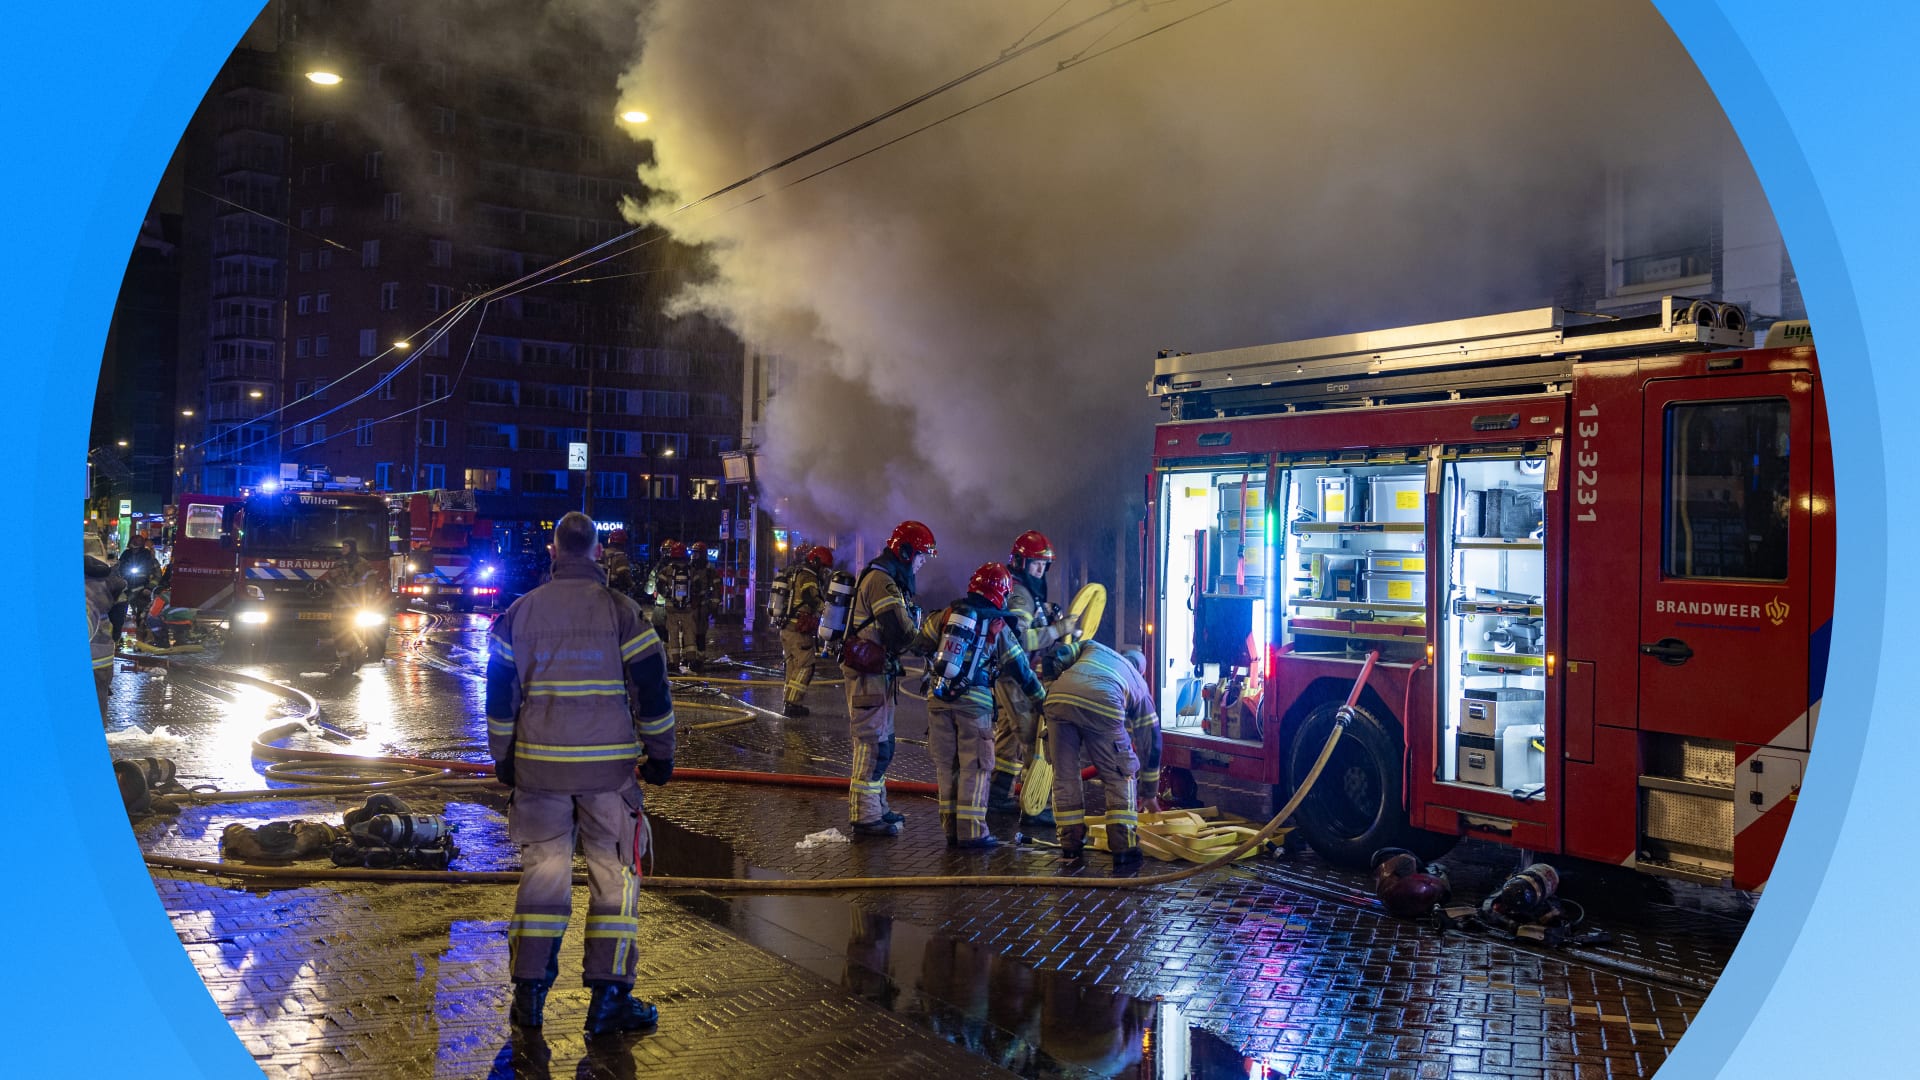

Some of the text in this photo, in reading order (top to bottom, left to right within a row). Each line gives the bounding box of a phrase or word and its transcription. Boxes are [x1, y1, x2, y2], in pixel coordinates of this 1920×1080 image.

[1326, 384, 1349, 393] Ergo
[1577, 404, 1599, 521] 13-3231
[300, 496, 338, 505] Willem
[1656, 600, 1760, 618] BRANDWEER
